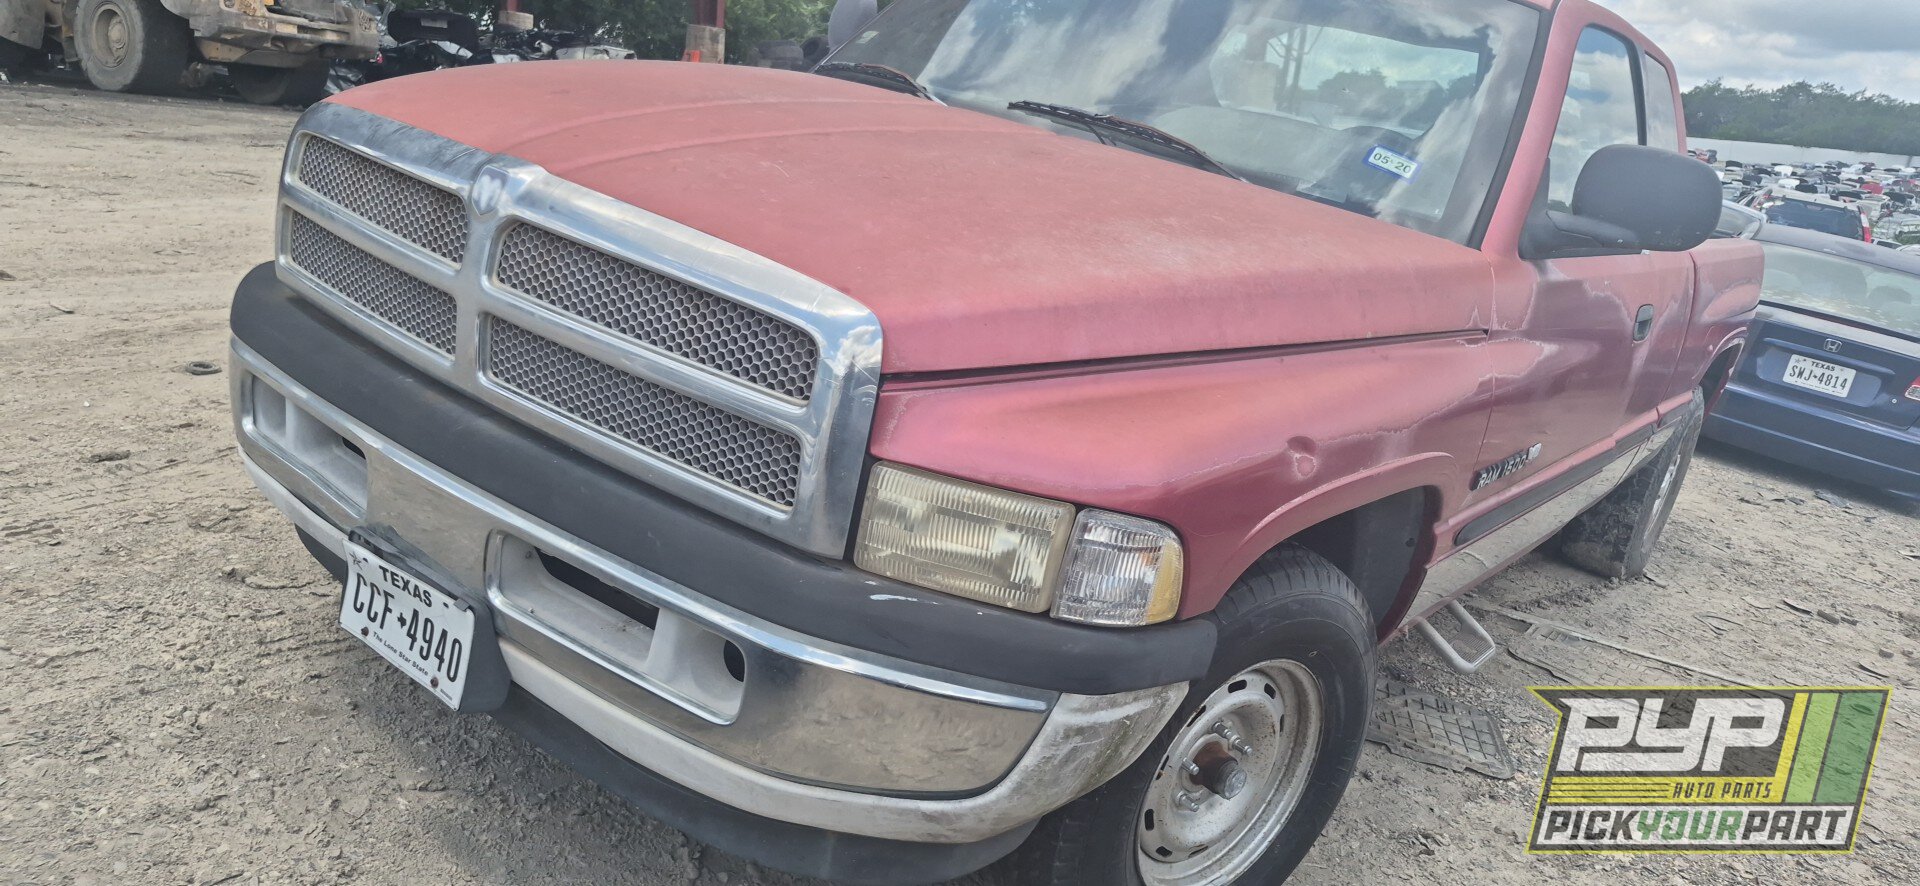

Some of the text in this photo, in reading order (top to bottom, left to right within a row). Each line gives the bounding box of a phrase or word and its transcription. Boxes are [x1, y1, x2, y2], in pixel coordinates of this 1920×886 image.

[1373, 152, 1412, 174] 05 20
[1811, 361, 1836, 372] TEXAS
[1477, 466, 1501, 490] RAM
[378, 564, 433, 608] TEXAS
[353, 572, 463, 683] CCF 4940
[372, 631, 429, 675] The Lone Star State
